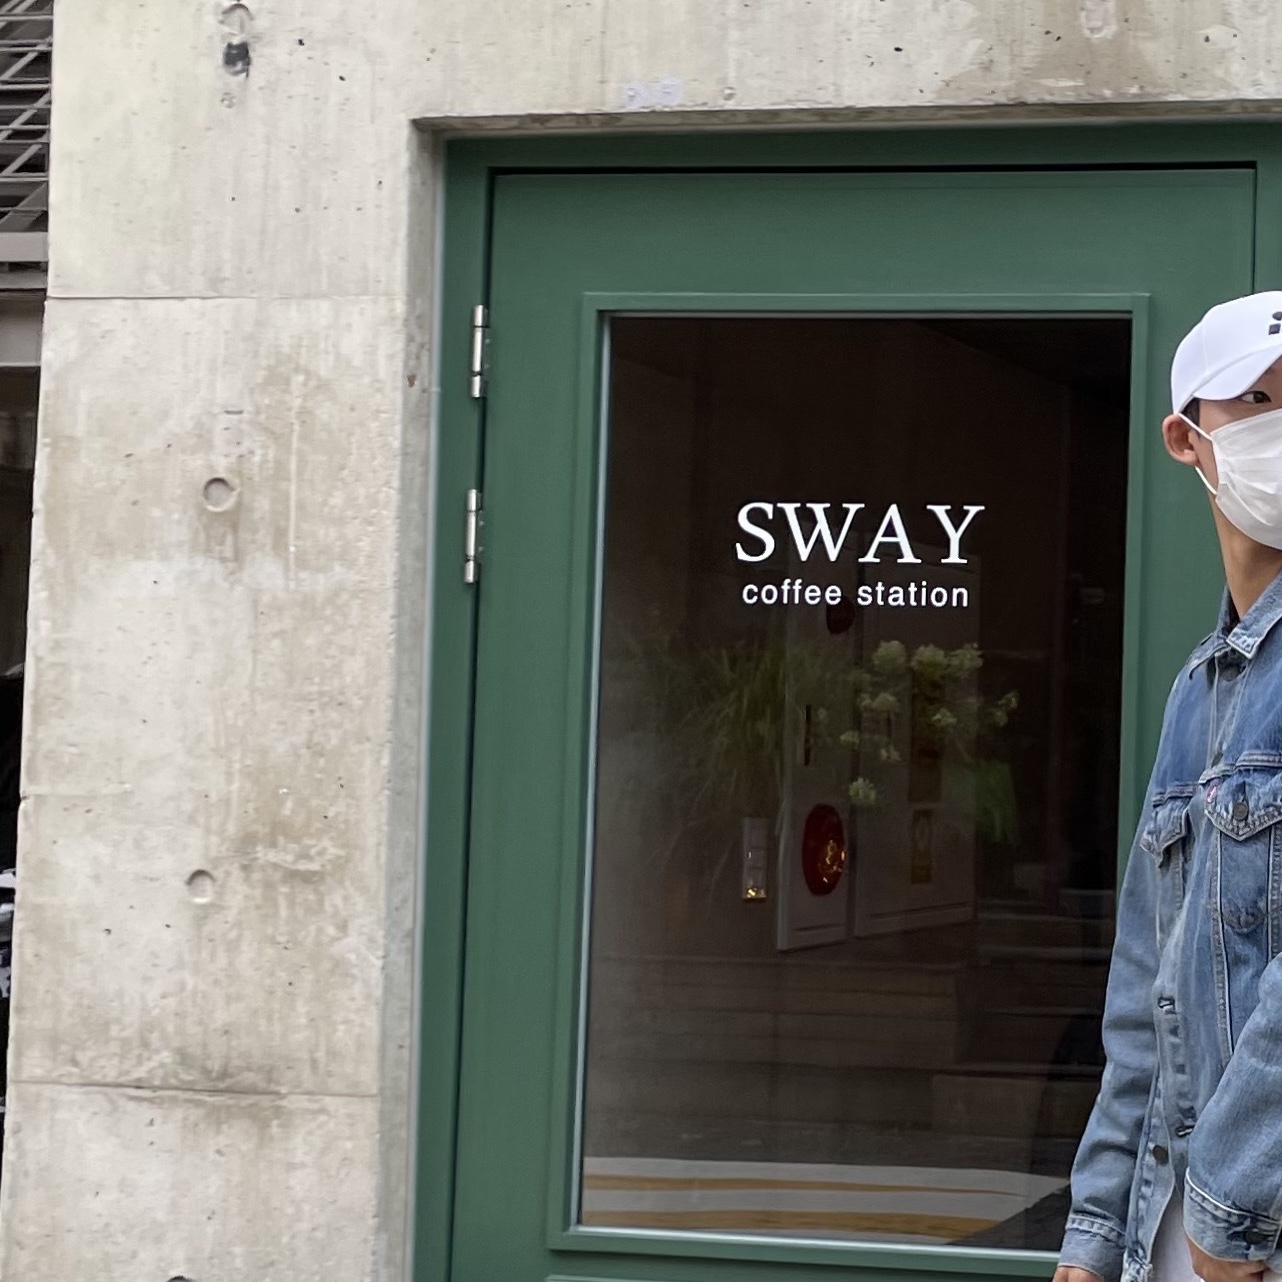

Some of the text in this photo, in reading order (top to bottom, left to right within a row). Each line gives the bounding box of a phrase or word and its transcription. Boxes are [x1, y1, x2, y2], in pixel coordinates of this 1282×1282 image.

[735, 501, 986, 564] SWAY
[742, 578, 969, 608] coffee station
